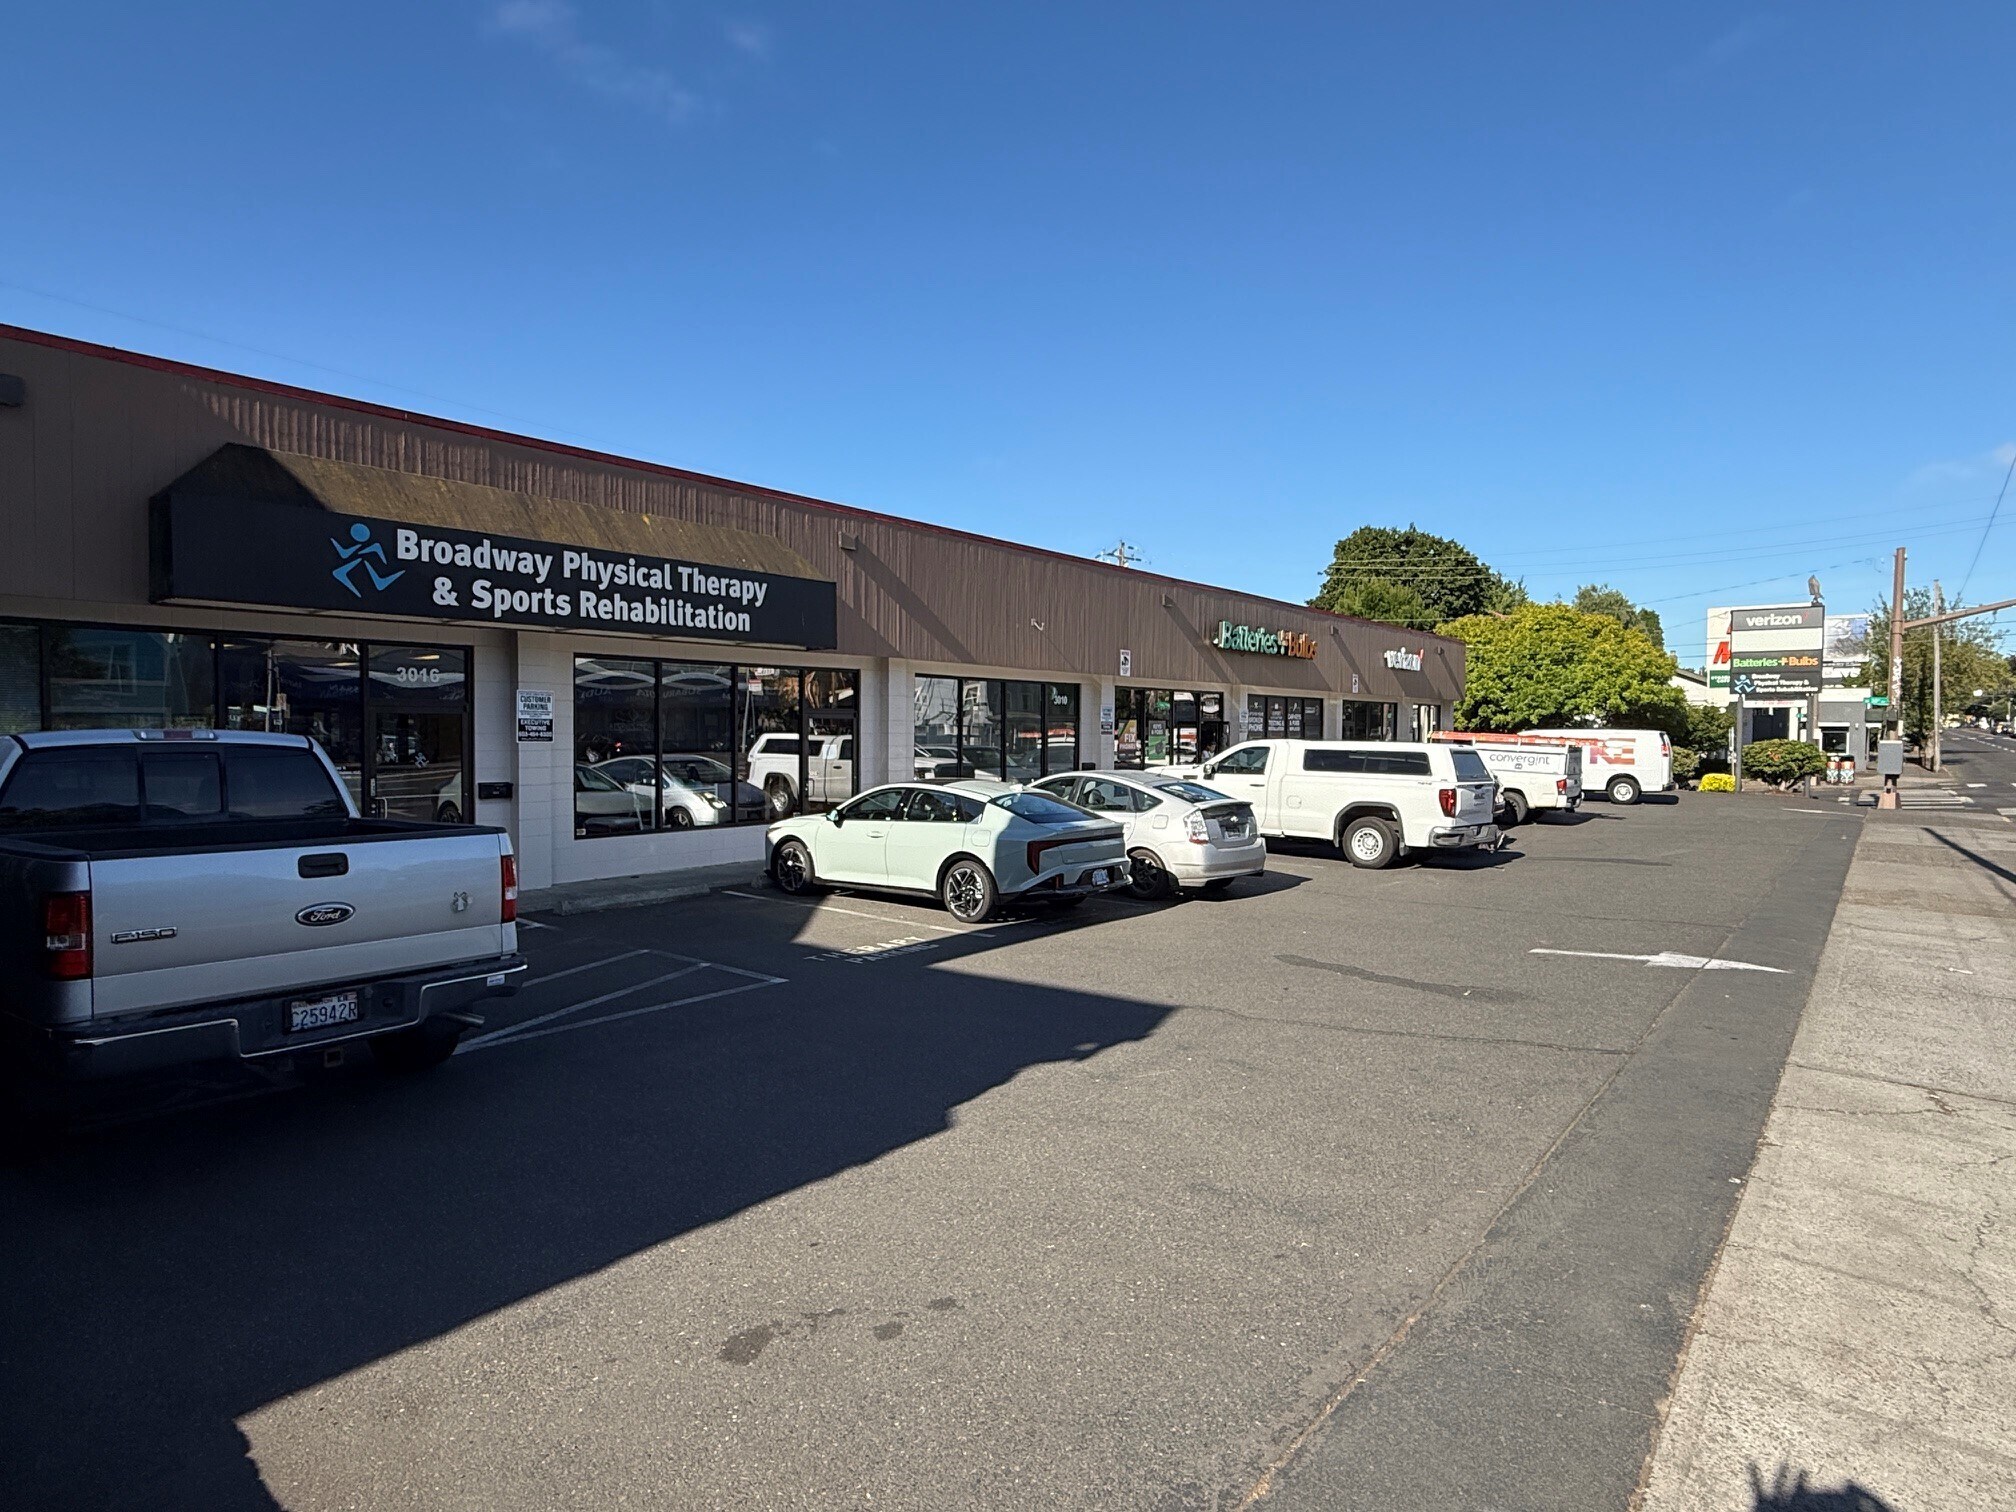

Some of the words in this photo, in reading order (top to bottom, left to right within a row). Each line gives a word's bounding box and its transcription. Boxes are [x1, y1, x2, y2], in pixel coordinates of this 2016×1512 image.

[396, 528, 553, 584] Broadway
[563, 550, 673, 591] Physical
[677, 565, 768, 608] Therapy
[432, 576, 460, 607] &
[471, 578, 572, 619] Sports
[579, 589, 751, 632] Rehabilitation
[1746, 613, 1802, 627] verizon
[1384, 646, 1421, 671] verizon
[396, 667, 441, 683] 3016
[520, 695, 551, 703] CUSTOMER
[1053, 695, 1068, 705] 3010
[1124, 734, 1136, 742] FIX
[310, 908, 341, 922] Ford
